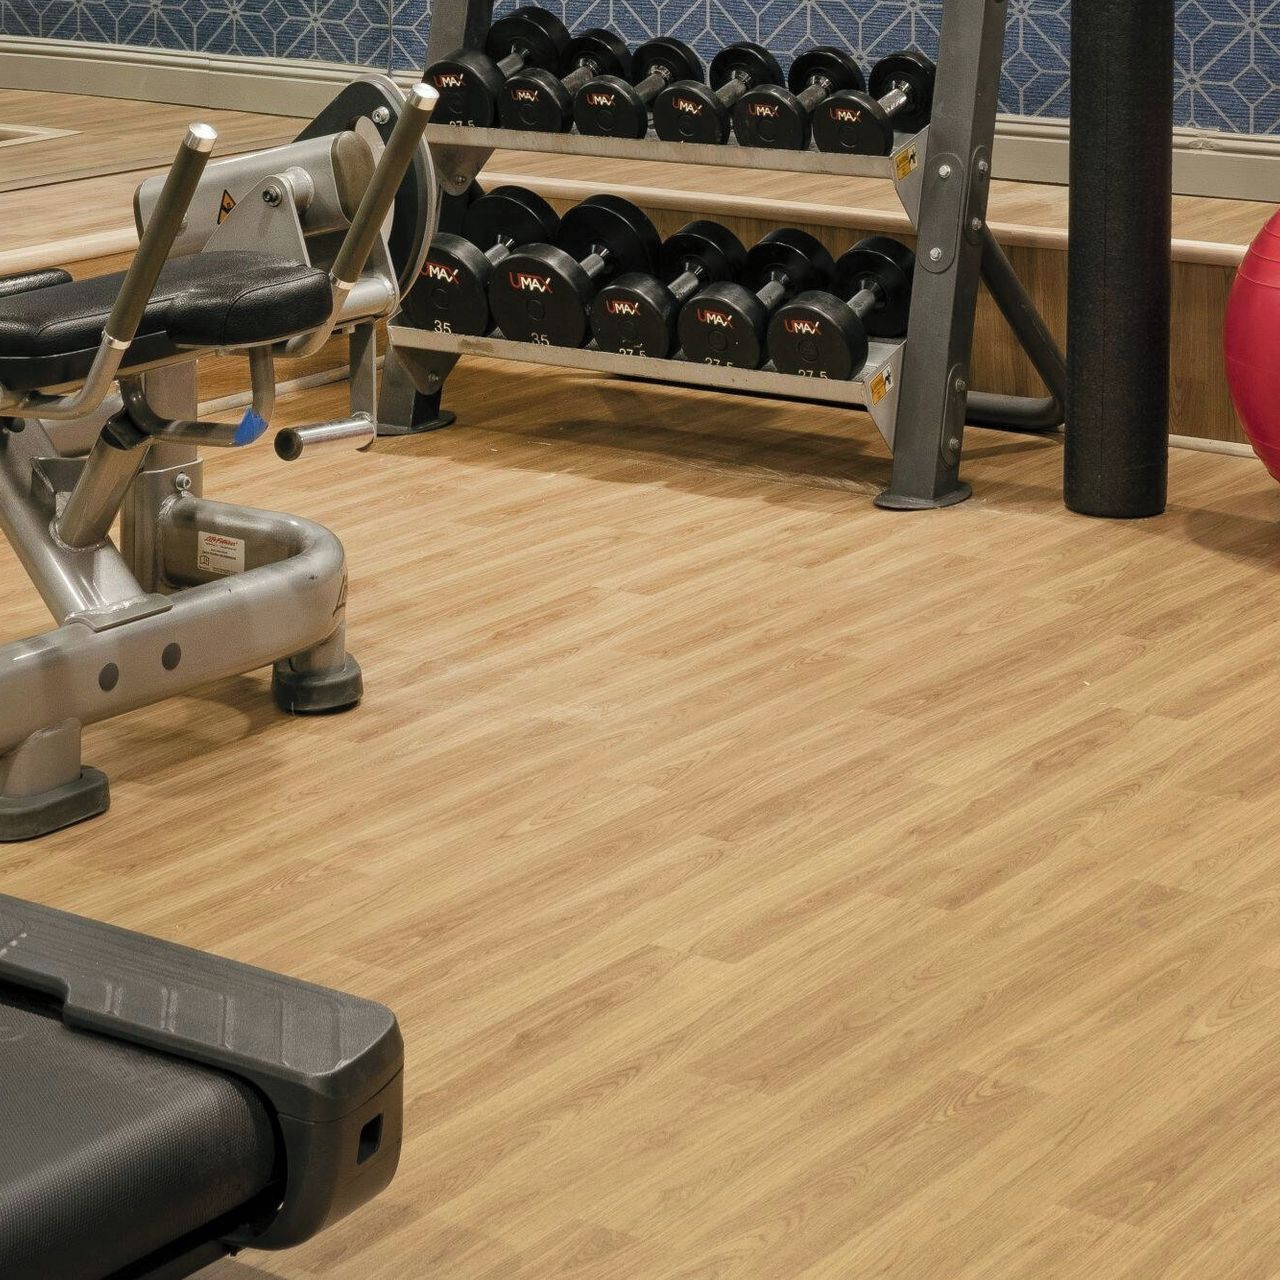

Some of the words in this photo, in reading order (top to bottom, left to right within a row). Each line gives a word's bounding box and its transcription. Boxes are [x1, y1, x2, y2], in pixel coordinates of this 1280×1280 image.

[433, 73, 465, 88] UMAX
[512, 89, 539, 102] UMAX
[586, 92, 615, 106] UMAX
[672, 98, 702, 115] UMAX
[749, 104, 779, 117] UMAX
[830, 107, 862, 122] UMAX
[509, 272, 552, 294] UMAX
[606, 299, 640, 316] UMAX
[697, 308, 734, 328] UMAX
[434, 320, 452, 336] 35
[784, 320, 822, 336] UMAX
[530, 332, 550, 346] 35
[619, 348, 647, 359] 275
[705, 358, 733, 368] 275
[798, 370, 828, 380] 275
